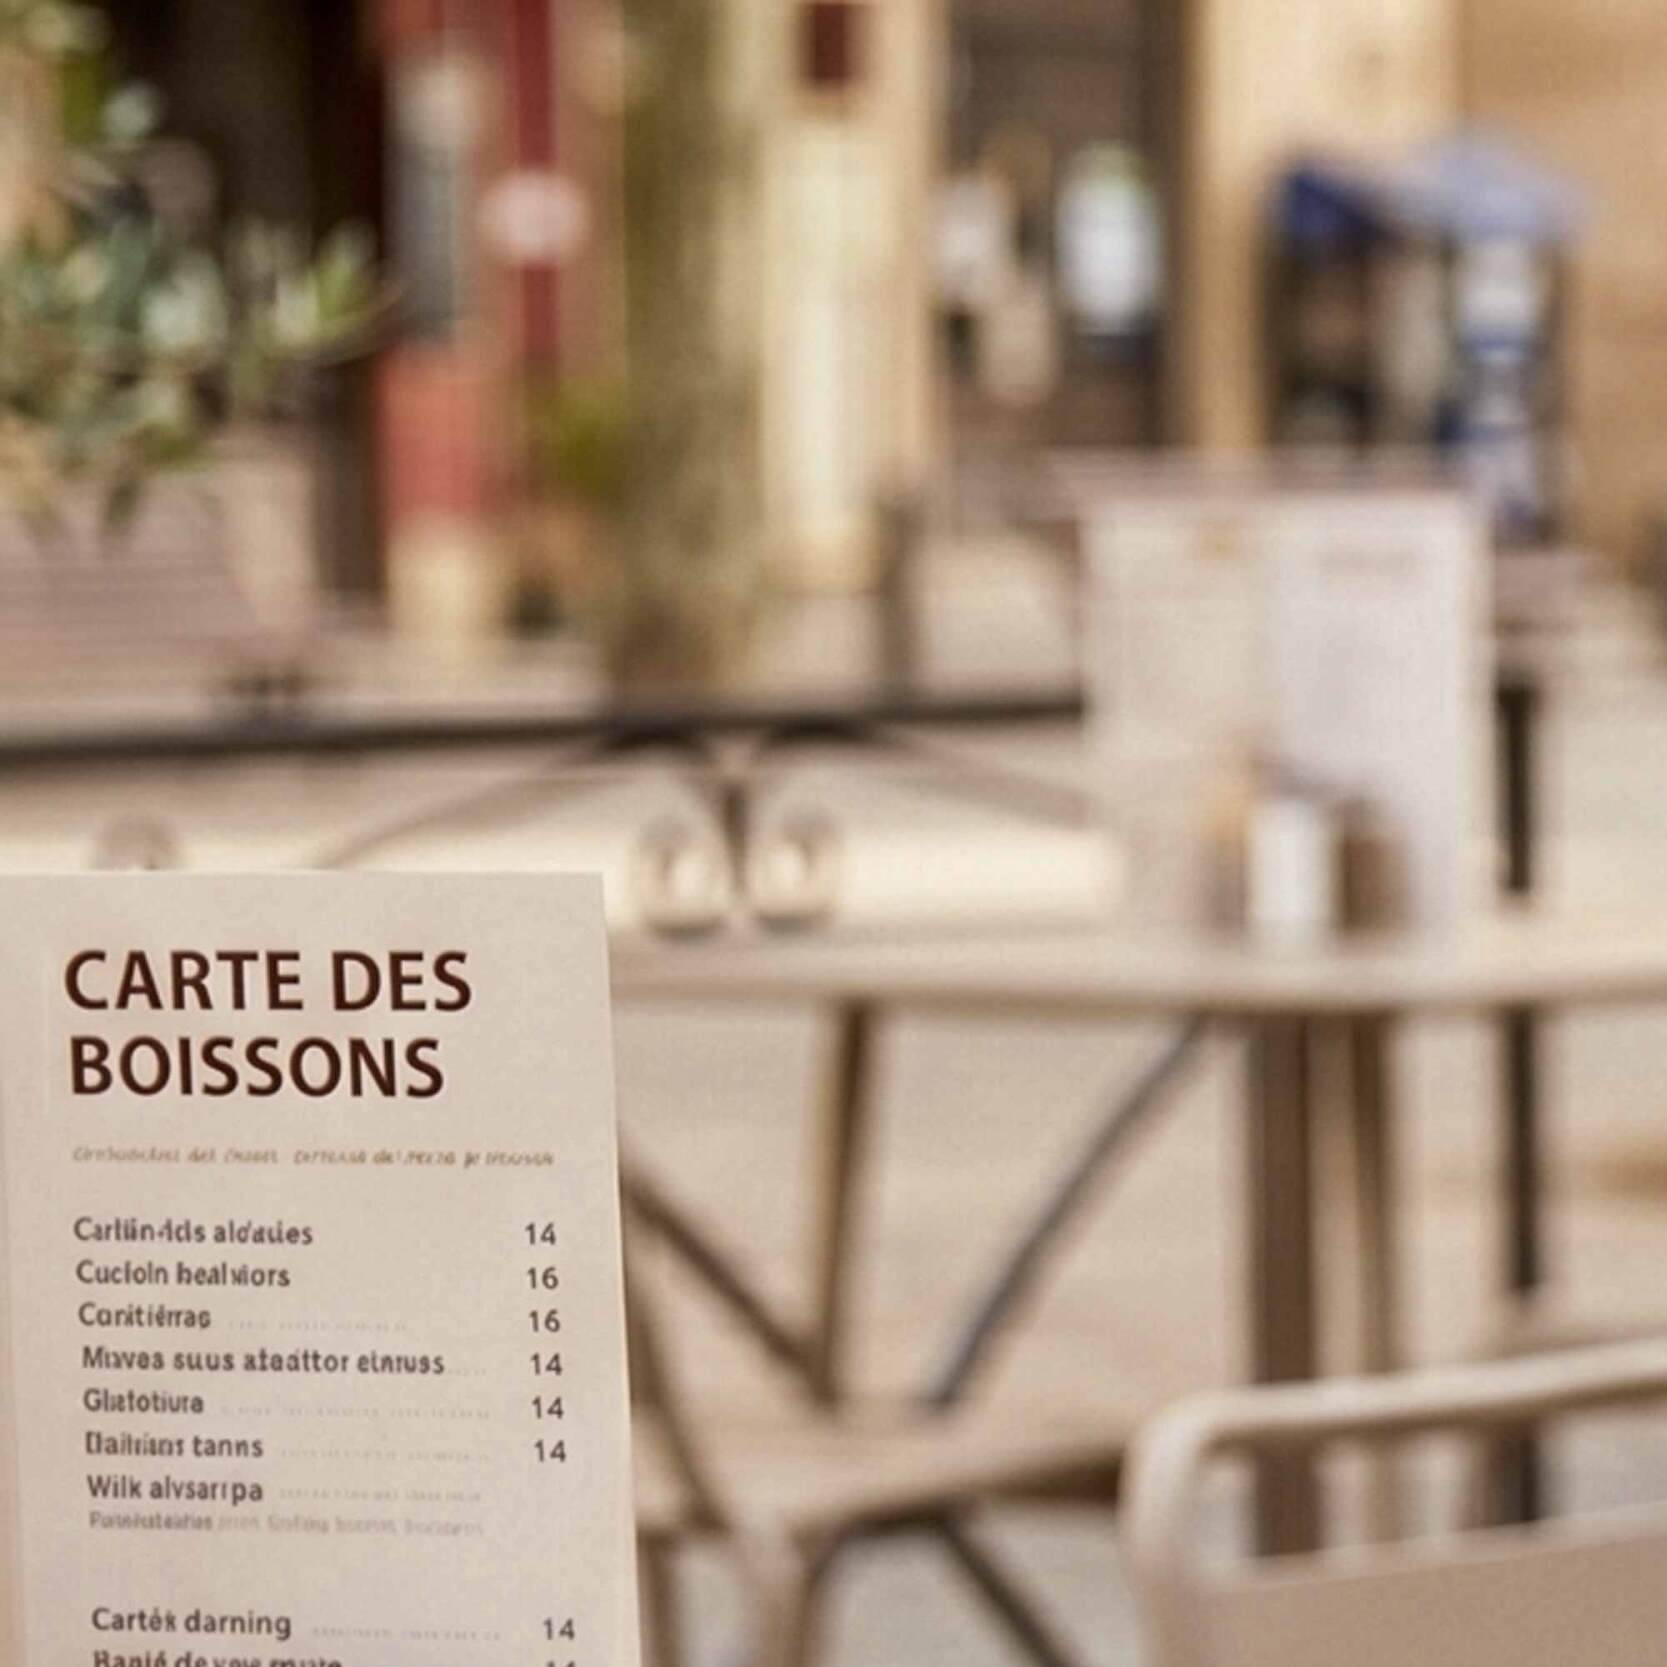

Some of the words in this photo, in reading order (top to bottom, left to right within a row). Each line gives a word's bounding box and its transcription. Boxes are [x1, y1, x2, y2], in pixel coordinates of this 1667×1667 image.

[64, 949, 304, 1011] CARTE
[332, 950, 472, 1012] DES
[70, 1035, 444, 1099] BOISSONS
[525, 1222, 557, 1246] 14
[527, 1266, 559, 1291] 16
[529, 1308, 561, 1333] 16
[530, 1352, 563, 1376] 14
[532, 1396, 565, 1420] 14
[534, 1439, 567, 1463] 14
[86, 1474, 142, 1499] Wilk
[183, 1608, 292, 1642] darning
[543, 1618, 576, 1641] 14
